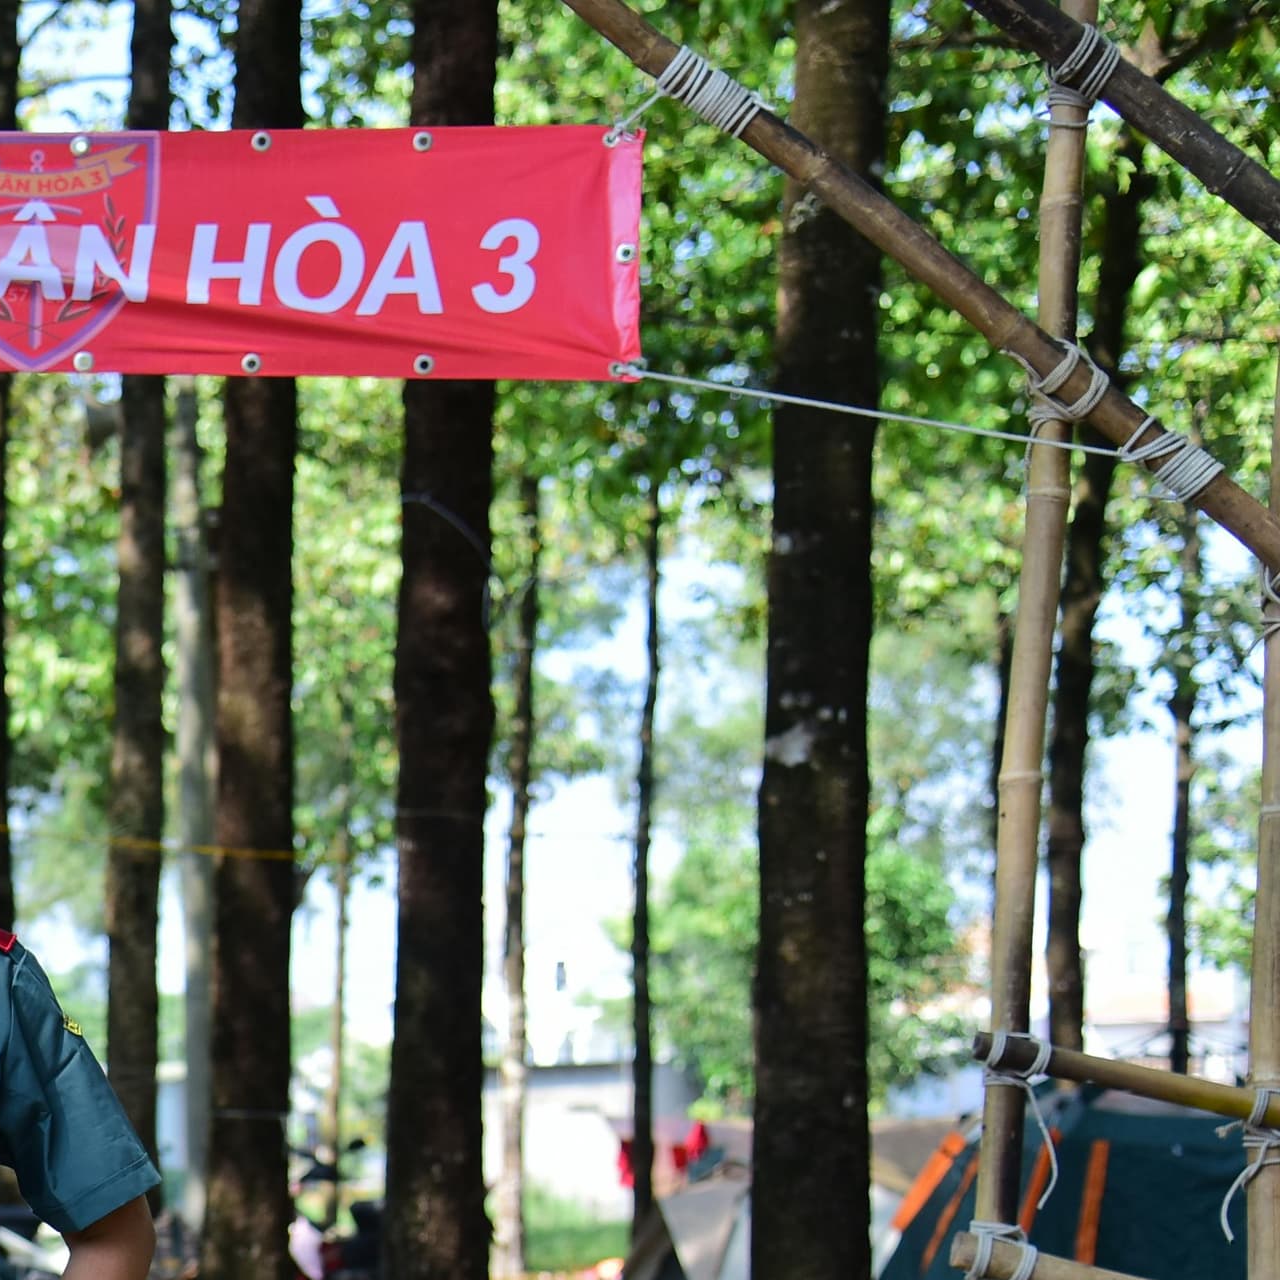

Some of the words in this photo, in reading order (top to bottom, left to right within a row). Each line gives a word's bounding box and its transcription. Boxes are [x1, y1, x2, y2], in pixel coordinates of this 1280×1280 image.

[37, 174, 85, 193] HÒA
[88, 170, 104, 186] 3
[186, 195, 444, 315] HÒA
[471, 218, 540, 314] 3
